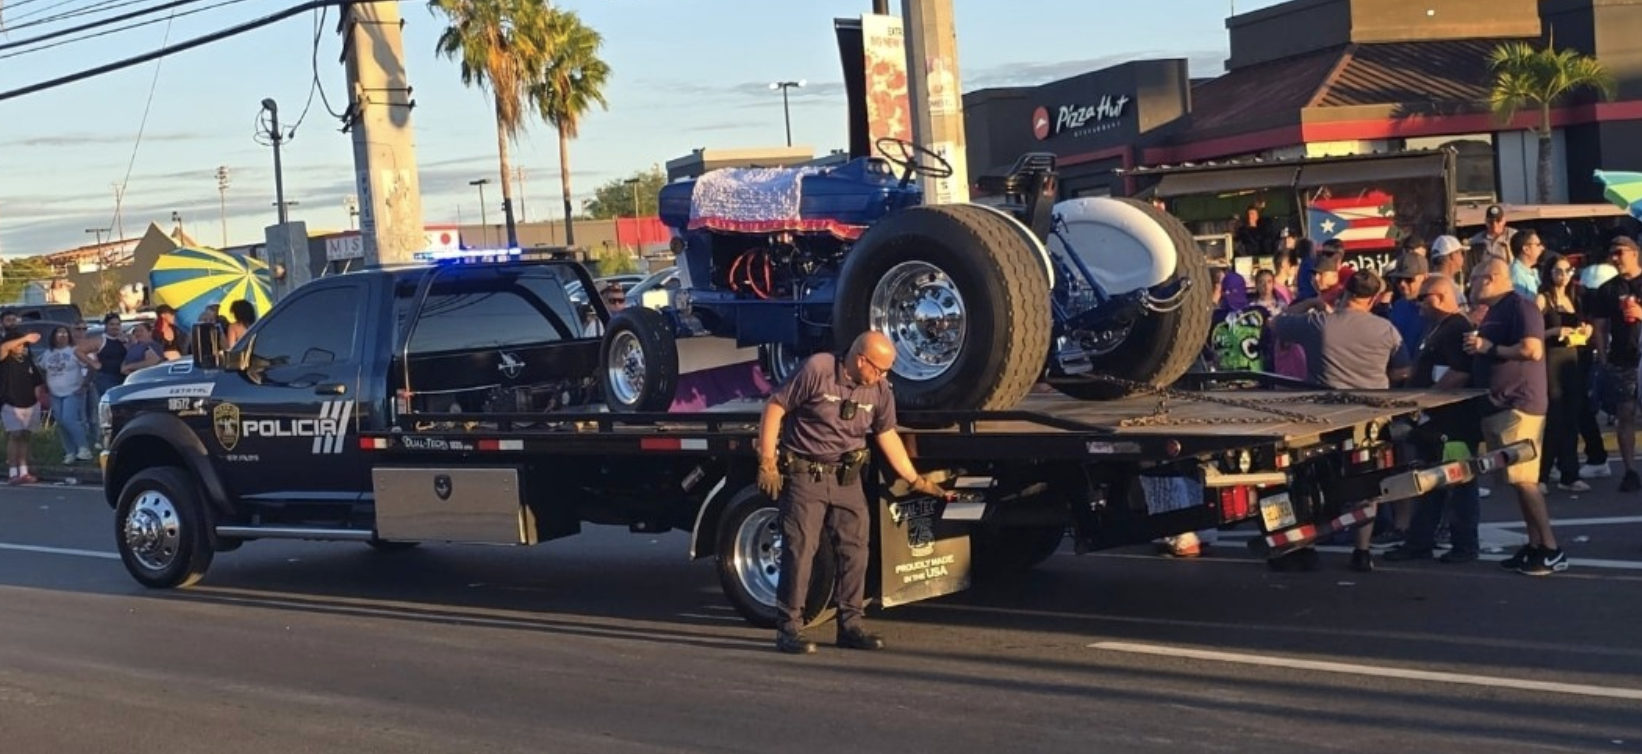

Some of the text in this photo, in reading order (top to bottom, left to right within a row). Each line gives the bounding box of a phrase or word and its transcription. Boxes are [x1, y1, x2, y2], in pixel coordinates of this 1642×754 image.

[1056, 95, 1130, 134] Pizza Hut
[169, 387, 209, 395] ESTATAL
[242, 419, 337, 437] POLICIA
[895, 554, 955, 574] PROUDLY MADE
[912, 573, 926, 581] THE
[925, 565, 949, 579] USA
